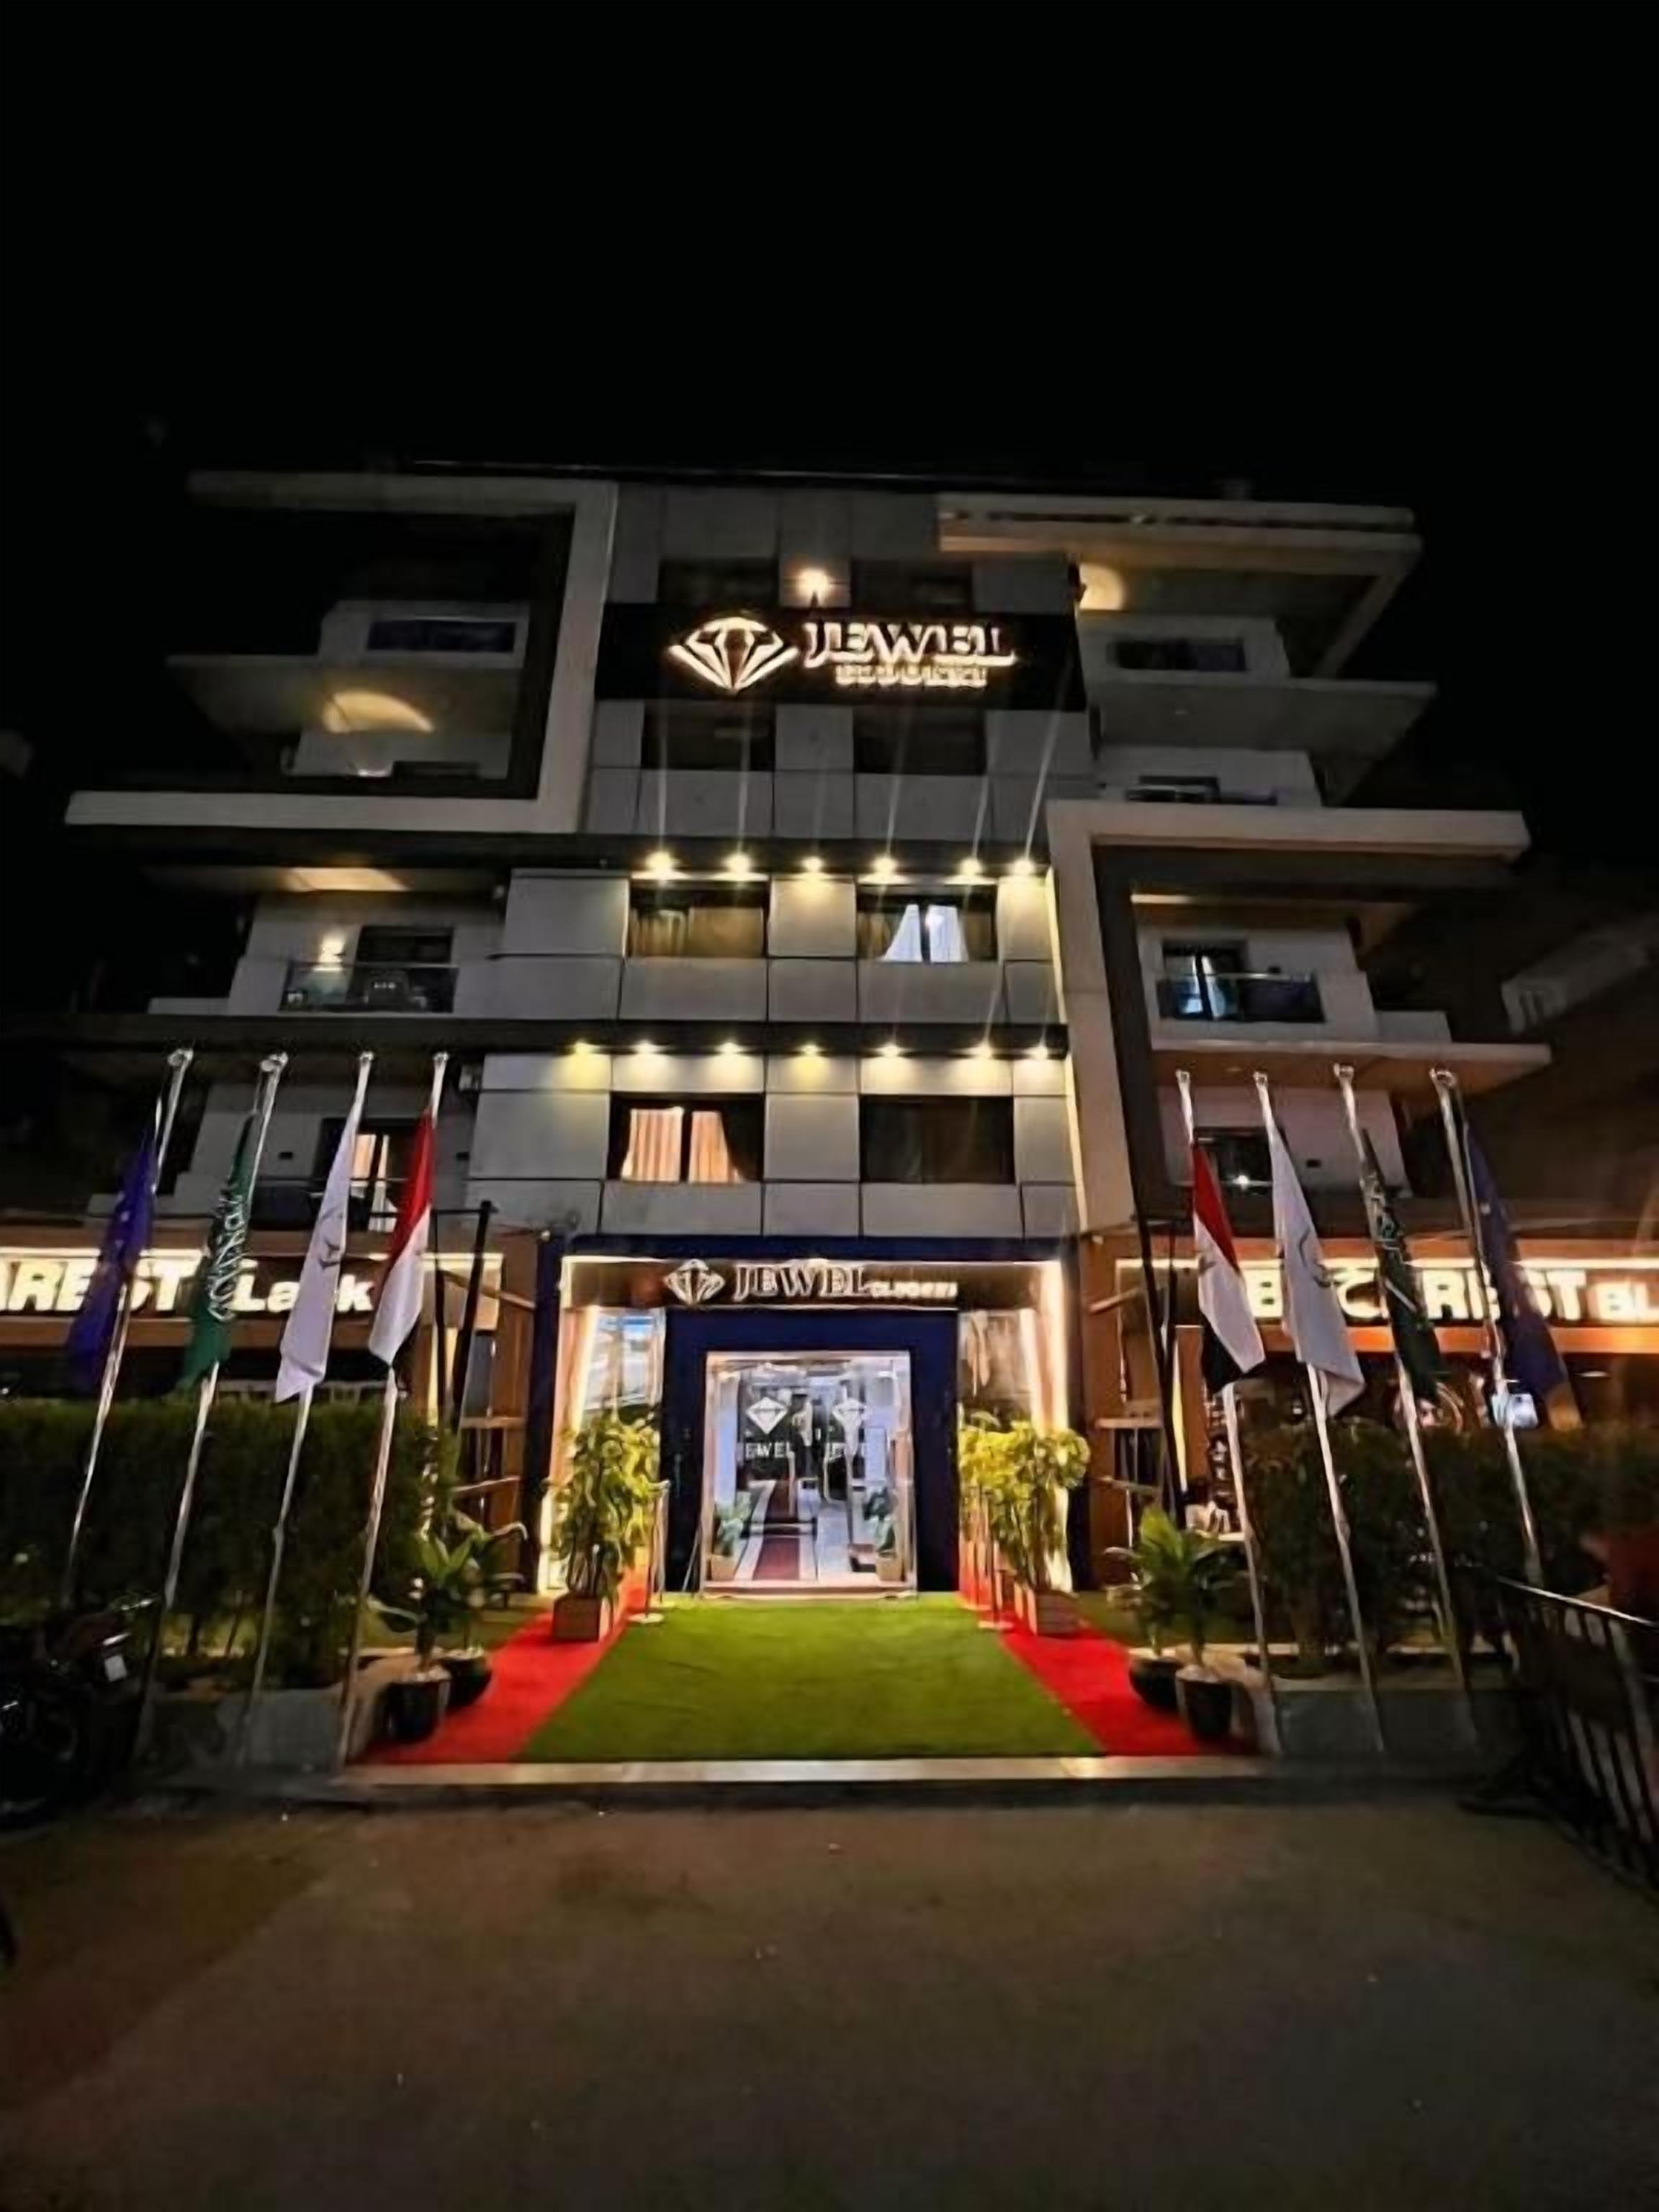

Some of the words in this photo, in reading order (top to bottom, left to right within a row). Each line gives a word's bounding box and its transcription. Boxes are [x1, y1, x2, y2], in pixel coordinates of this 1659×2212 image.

[802, 621, 1015, 668] JEWEL
[0, 1259, 201, 1311] REST
[734, 1265, 870, 1302] JEWEL
